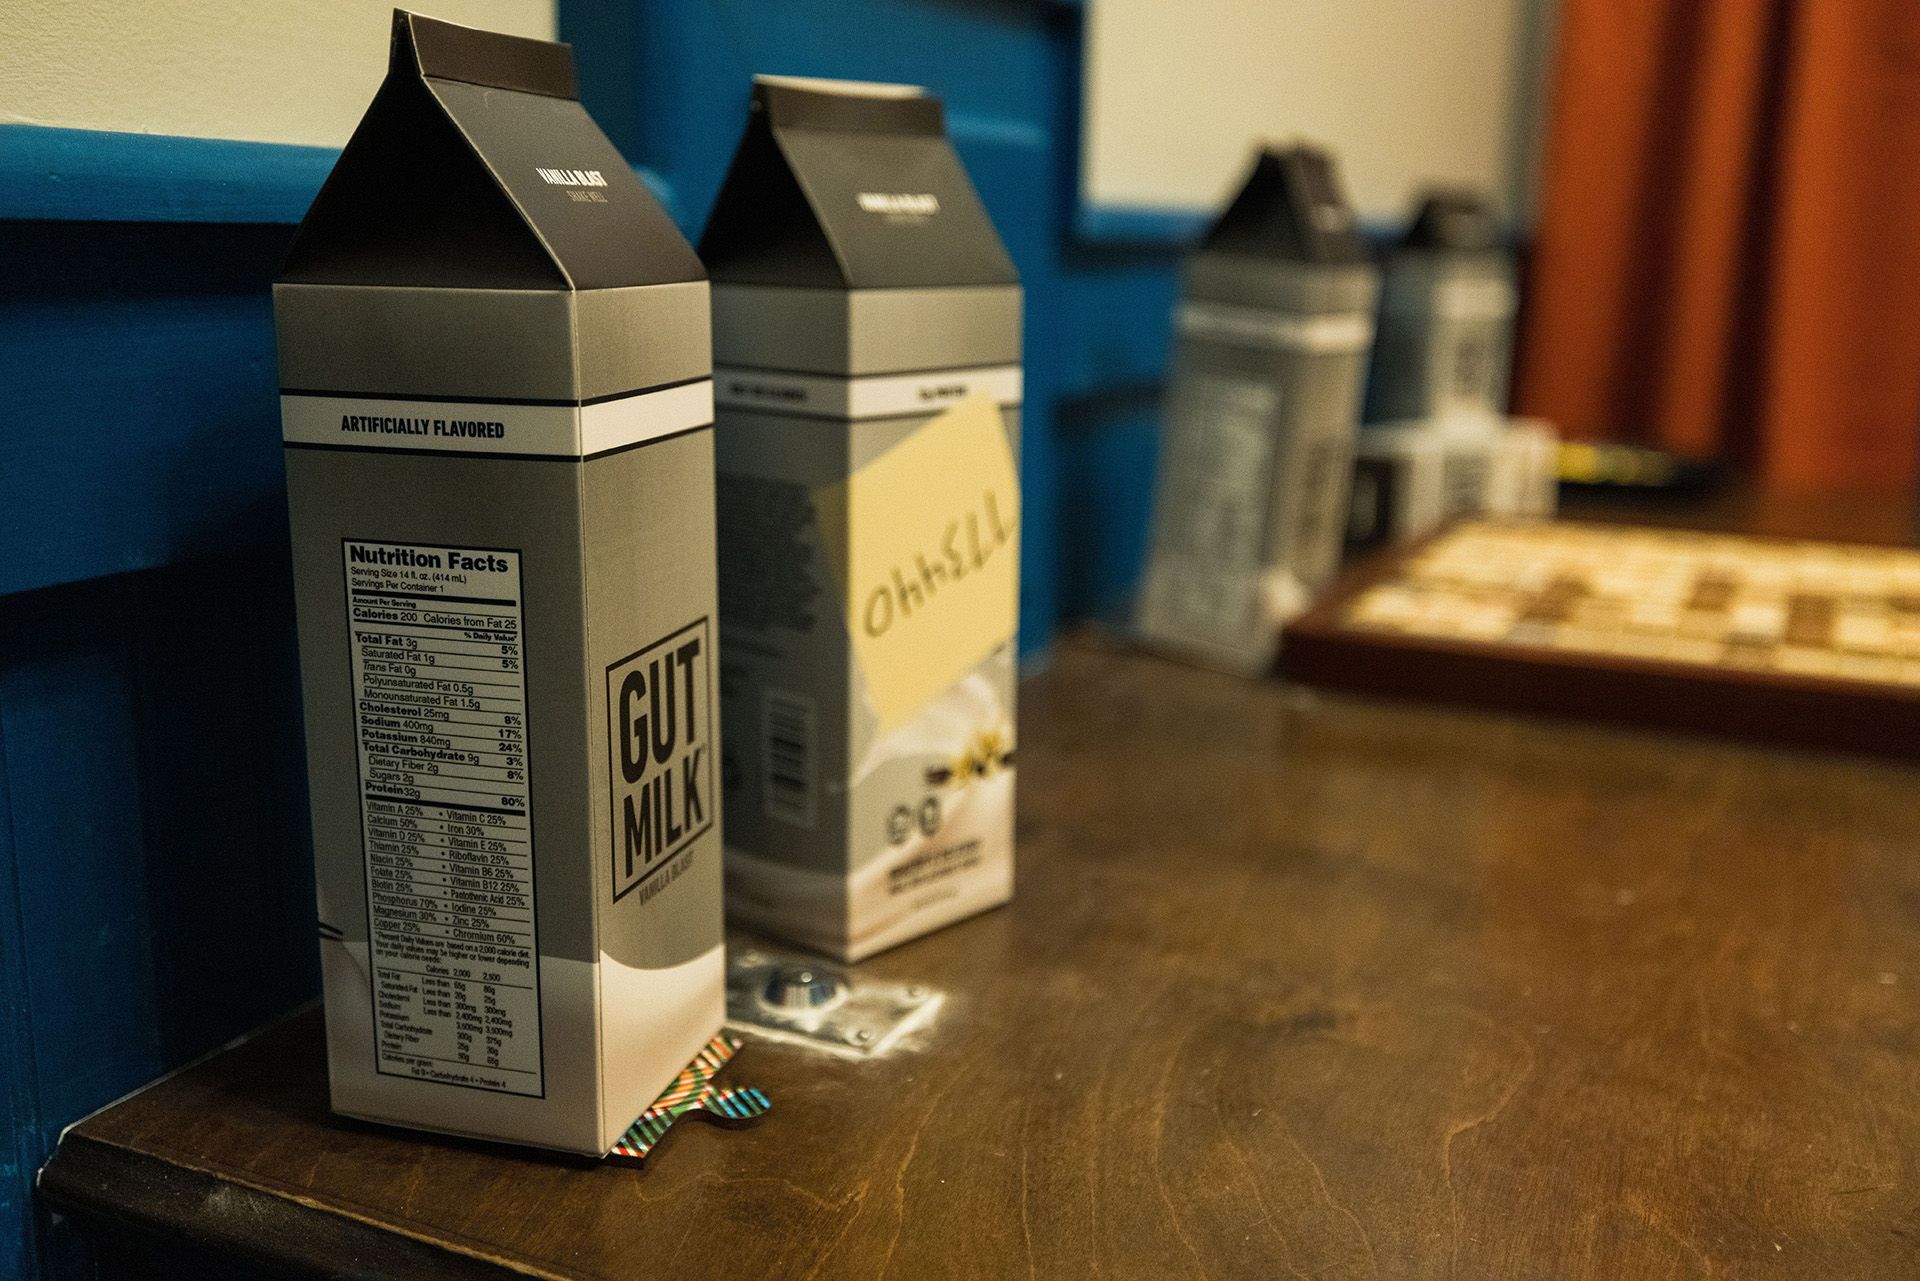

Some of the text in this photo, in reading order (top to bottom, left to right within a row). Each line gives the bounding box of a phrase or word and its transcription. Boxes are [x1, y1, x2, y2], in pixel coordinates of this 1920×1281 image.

[535, 167, 608, 187] VANILLA BLAST
[341, 415, 505, 438] ARTIFICIALLY FLAVORED
[350, 545, 508, 573] Nutrition Facts
[351, 566, 379, 578] Serving
[380, 568, 398, 578] Size
[400, 570, 409, 579] 14
[432, 573, 450, 582] (414
[451, 574, 467, 584] mL)
[352, 577, 384, 590] Servings
[386, 580, 398, 589] Per
[400, 581, 438, 592] Container
[353, 607, 517, 629] Calories 200 Calories from Fat 25
[473, 632, 492, 641] Daily
[356, 634, 518, 655] Total Fat 3g 5%
[361, 648, 518, 669] Saturated Fat 1g 5%
[364, 663, 416, 676] Trans Fat 0g
[363, 675, 473, 695] Polyunsaturated Fat 0.5g
[364, 690, 480, 709] Monounsaturated Fat 1.5g
[359, 702, 521, 726] Cholesterol 25mg 8%
[619, 638, 700, 784] GUT
[361, 715, 522, 739] Sodium 400mg 17%
[362, 728, 522, 753] Potassium 840mg 24%
[362, 742, 523, 767] Total Carbohydrate 9g 3%
[368, 756, 524, 780] Dietary Fiber 2g 8%
[369, 770, 414, 784] Sugars 2g
[366, 801, 423, 816] Vitamin A 25%
[501, 796, 525, 807] 80%
[446, 810, 506, 825] Vitamin C 25%
[623, 748, 703, 879] MILK
[367, 814, 418, 829] Calcium 50%
[368, 827, 425, 842] Vitamin D 25%
[448, 824, 484, 836] Iron 30%
[369, 840, 419, 855] Thiamin 25%
[448, 837, 507, 851] Vitamin E 25%
[370, 853, 413, 867] Niacin 25%
[449, 850, 509, 865] Riboflavin 25%
[370, 866, 413, 880] Folate 25%
[449, 863, 514, 878] Vitamin B6 25%
[372, 879, 413, 893] Biotin 25%
[450, 876, 520, 893] Vitamin B12 25%
[372, 892, 438, 909] Phosphorus 70%
[490, 894, 504, 904] Acid
[506, 896, 525, 906] 25%
[373, 904, 437, 922] Magnesium 30%
[452, 902, 496, 916] Iodine 25%
[374, 918, 420, 932] Copper 25%
[452, 915, 490, 928] Zinc 25%
[453, 928, 515, 944] Chromium 60%
